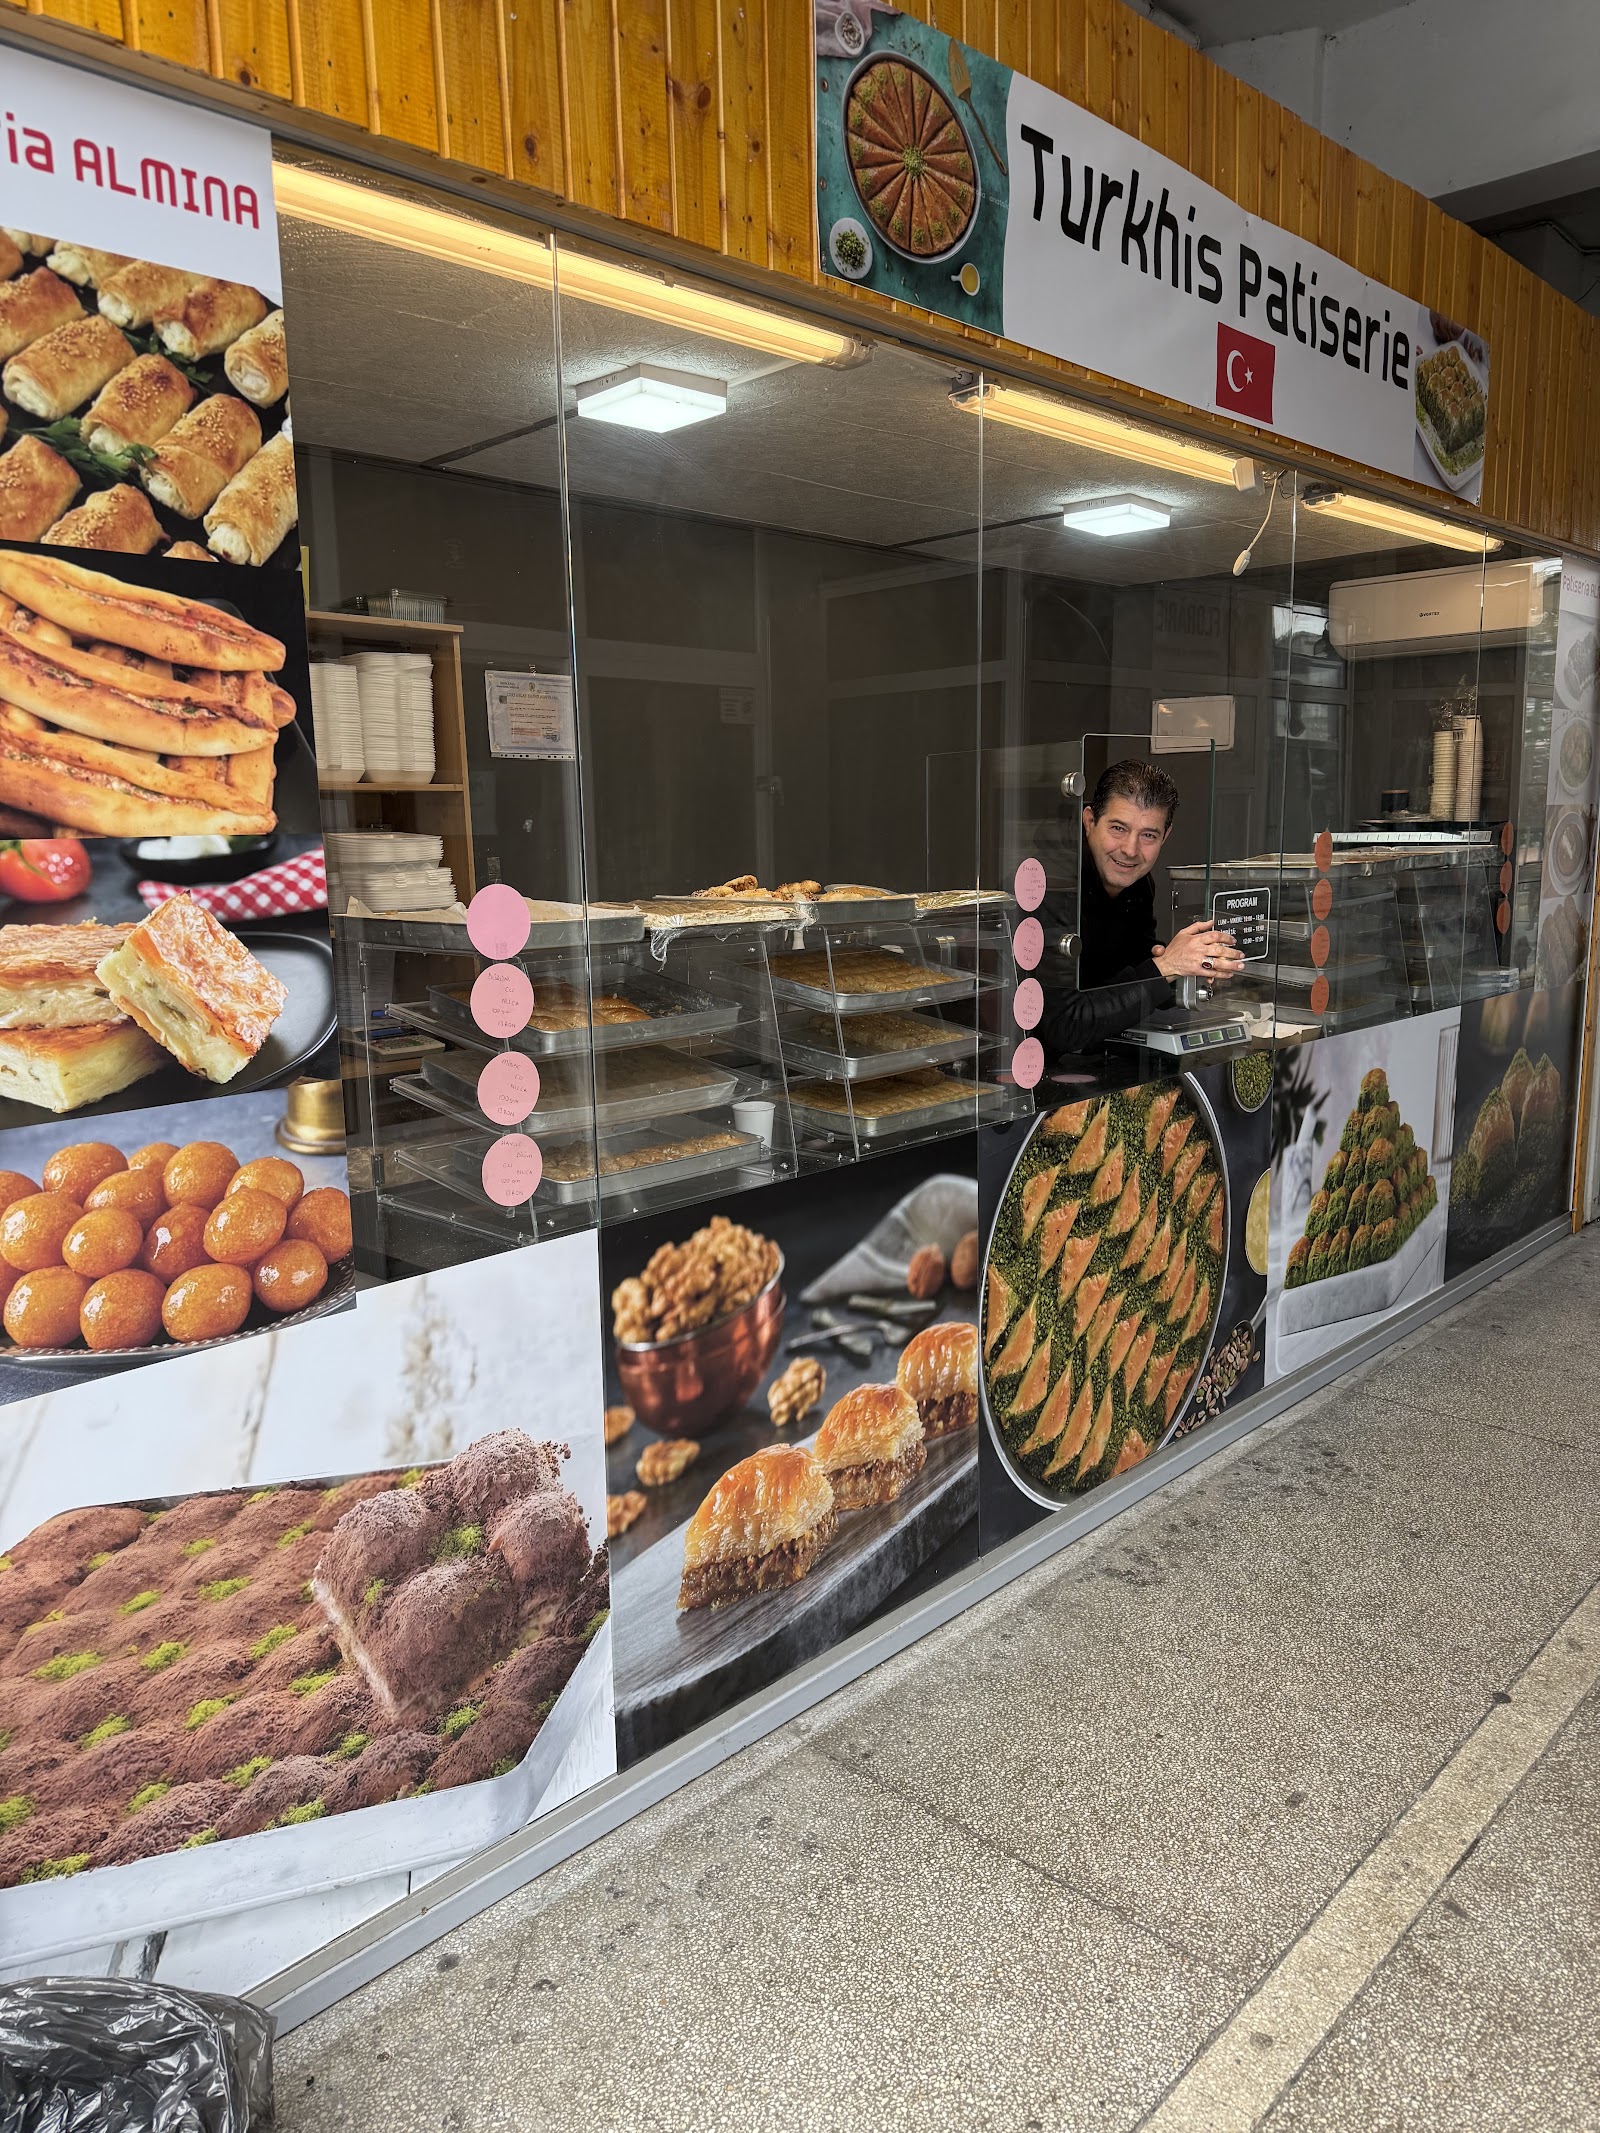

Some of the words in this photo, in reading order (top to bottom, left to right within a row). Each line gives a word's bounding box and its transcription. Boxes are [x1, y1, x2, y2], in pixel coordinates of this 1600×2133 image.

[0, 111, 55, 175] ia
[73, 138, 260, 230] ALMINA
[1020, 123, 1222, 305] Turkhis
[1239, 243, 1411, 391] Patiserie
[1226, 896, 1258, 910] PROGRAM
